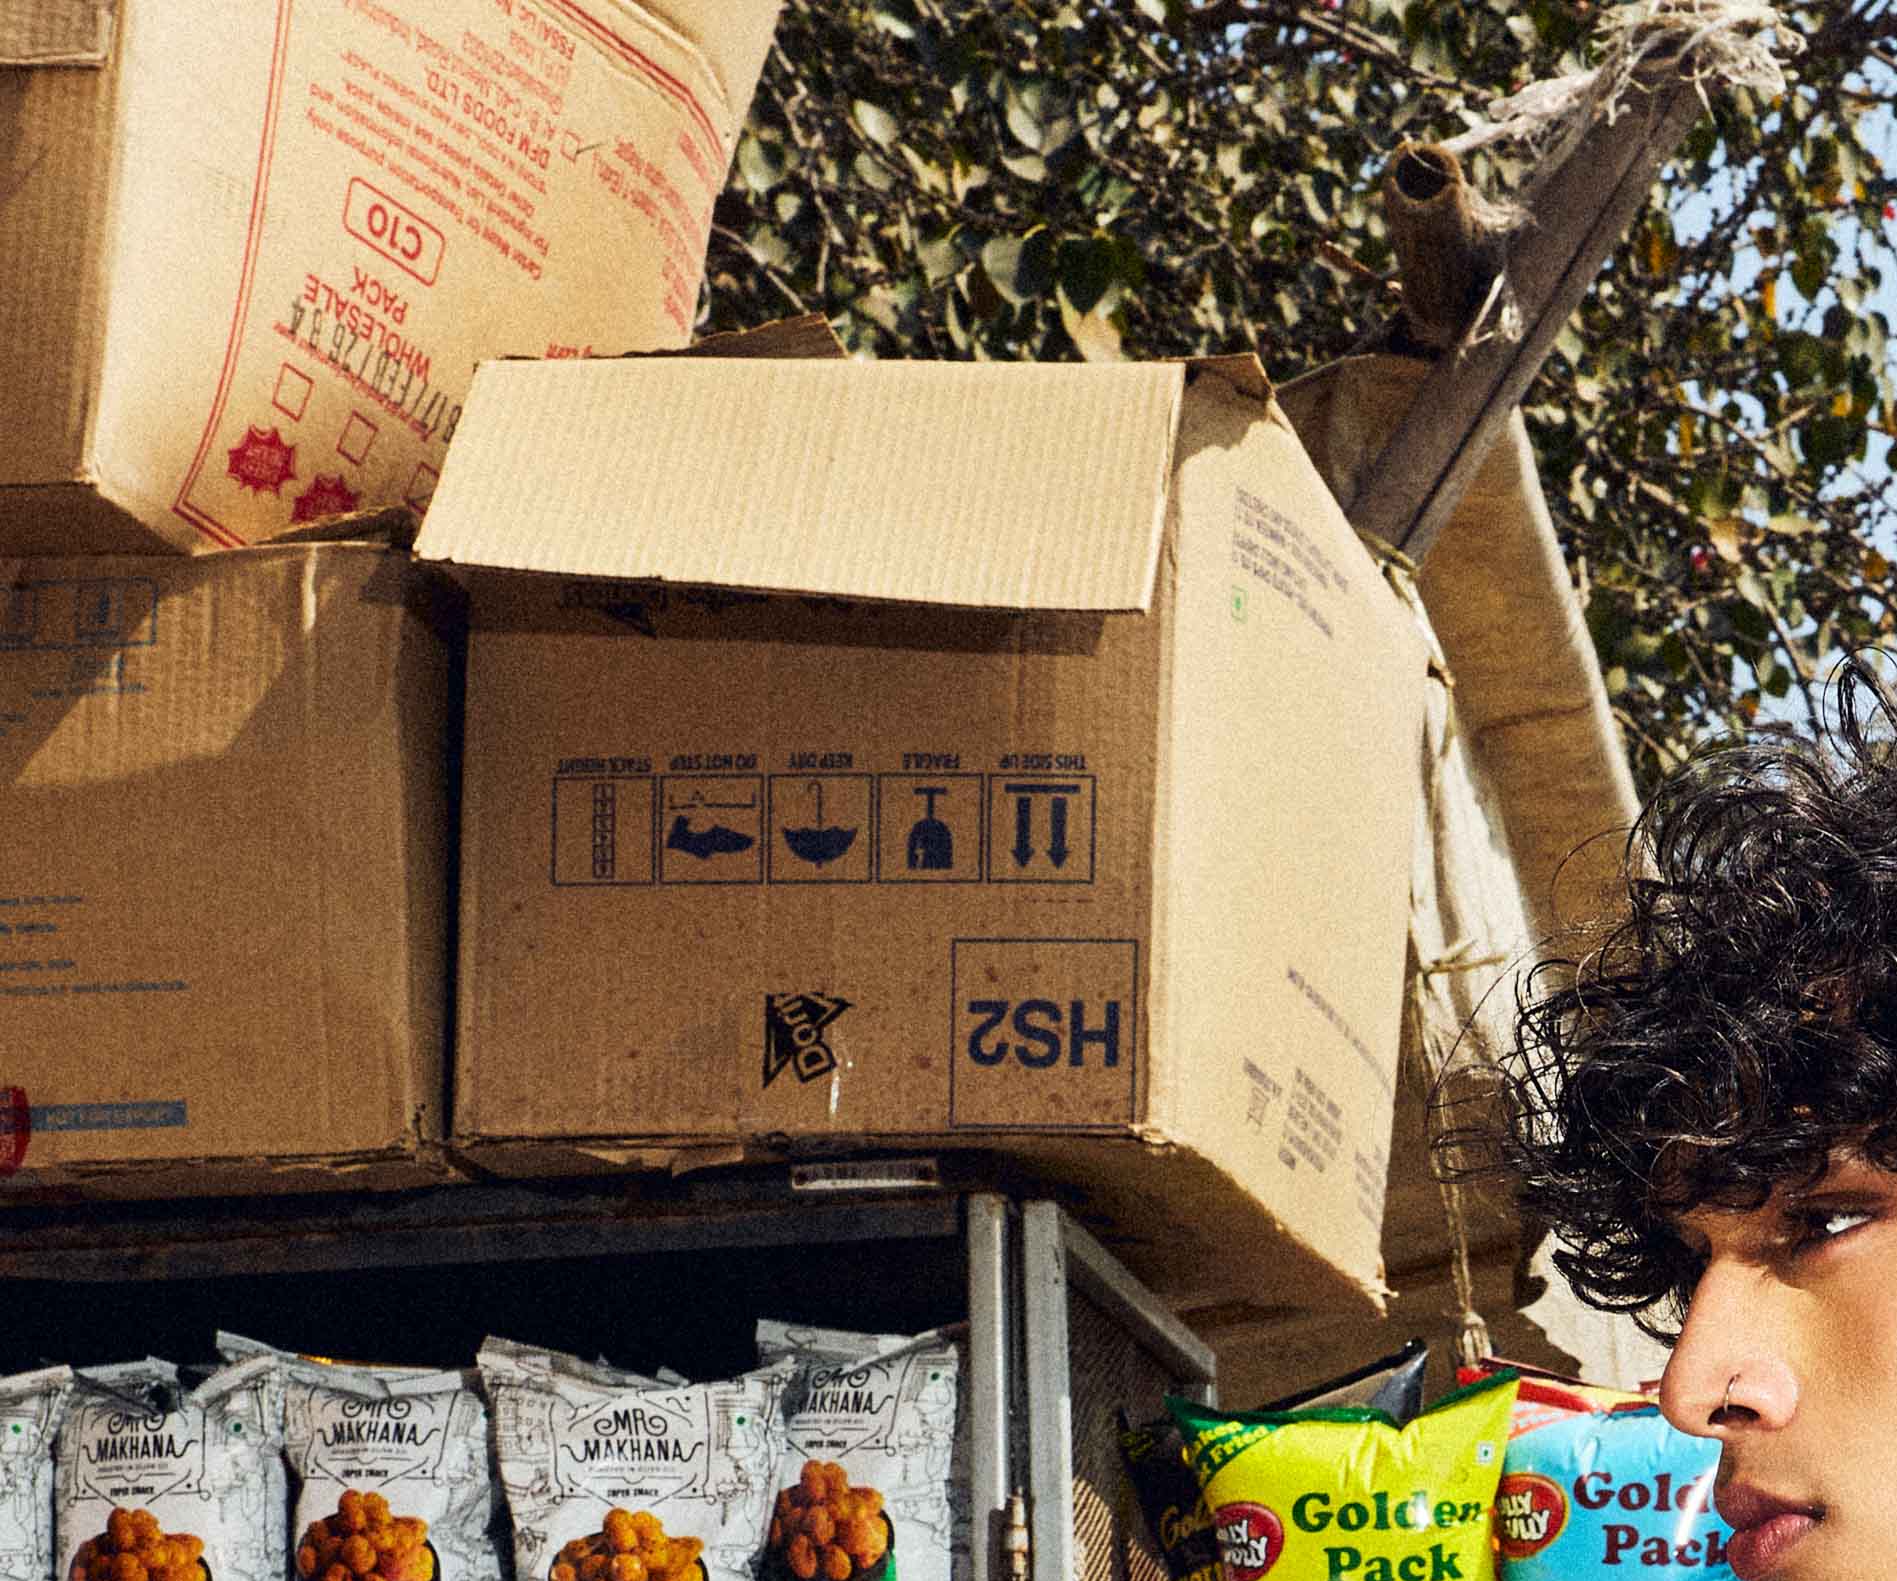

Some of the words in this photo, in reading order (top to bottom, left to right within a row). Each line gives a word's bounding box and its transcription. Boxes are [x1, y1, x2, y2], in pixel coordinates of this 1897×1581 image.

[458, 91, 517, 146] FOODS
[515, 131, 551, 170] DFM
[367, 203, 425, 261] C10
[352, 265, 408, 325] PACK
[303, 274, 431, 382] WHOLESALE
[968, 999, 1120, 1069] HS2
[317, 1421, 442, 1447] MAKHANA
[593, 1408, 668, 1437] MR
[83, 1435, 198, 1464] MAKHANA
[560, 1437, 705, 1464] MAKHANA
[1291, 1490, 1482, 1533] Golden
